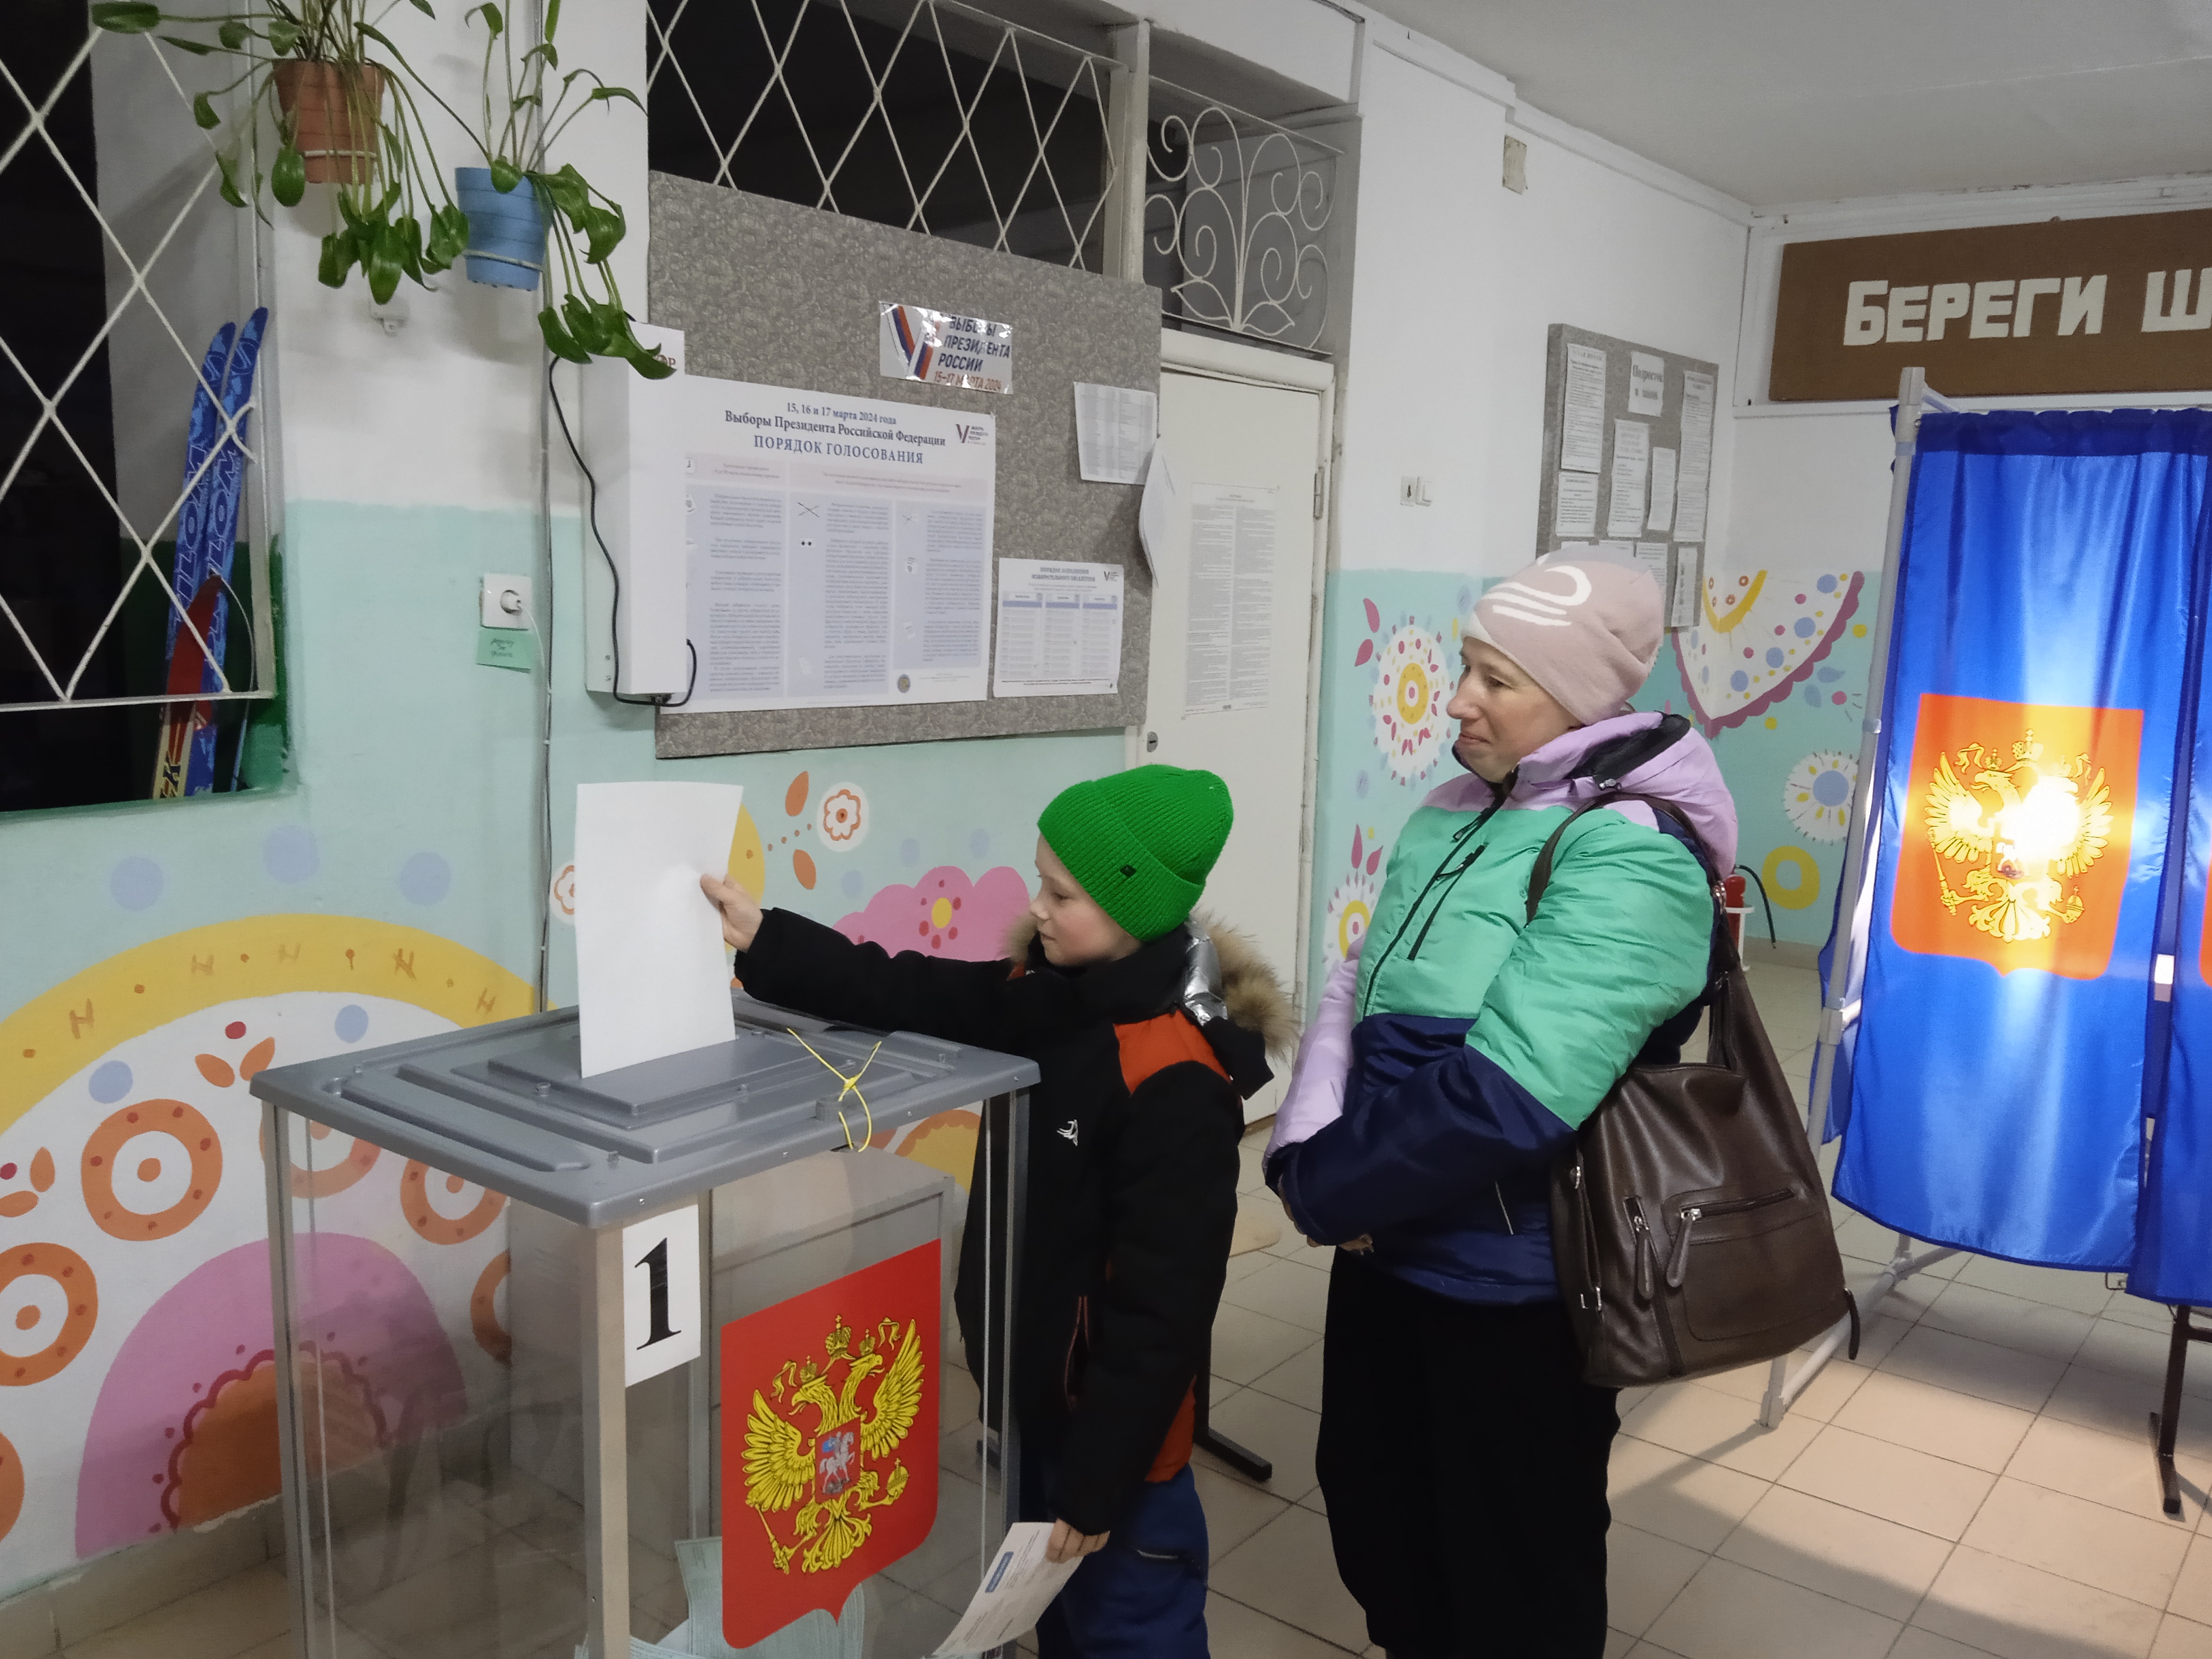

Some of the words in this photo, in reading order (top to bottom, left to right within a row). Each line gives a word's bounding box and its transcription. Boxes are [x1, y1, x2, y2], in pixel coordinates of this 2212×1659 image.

[1844, 275, 2107, 346] БЕРЕГИ
[938, 353, 984, 372] РОССИИ
[725, 410, 772, 428] Выборы
[774, 416, 835, 434] Президента
[838, 424, 894, 441] Российской
[896, 430, 946, 447] Федерации
[787, 403, 799, 414] 15,
[802, 405, 811, 414] 16
[822, 407, 831, 416] 17
[833, 410, 857, 421] марта
[859, 412, 878, 422] 2024
[879, 415, 896, 425] года
[753, 435, 822, 454] ПОРЯДОК
[826, 443, 924, 464] ГОЛОСОВАНИЯ
[634, 1237, 682, 1351] 1
